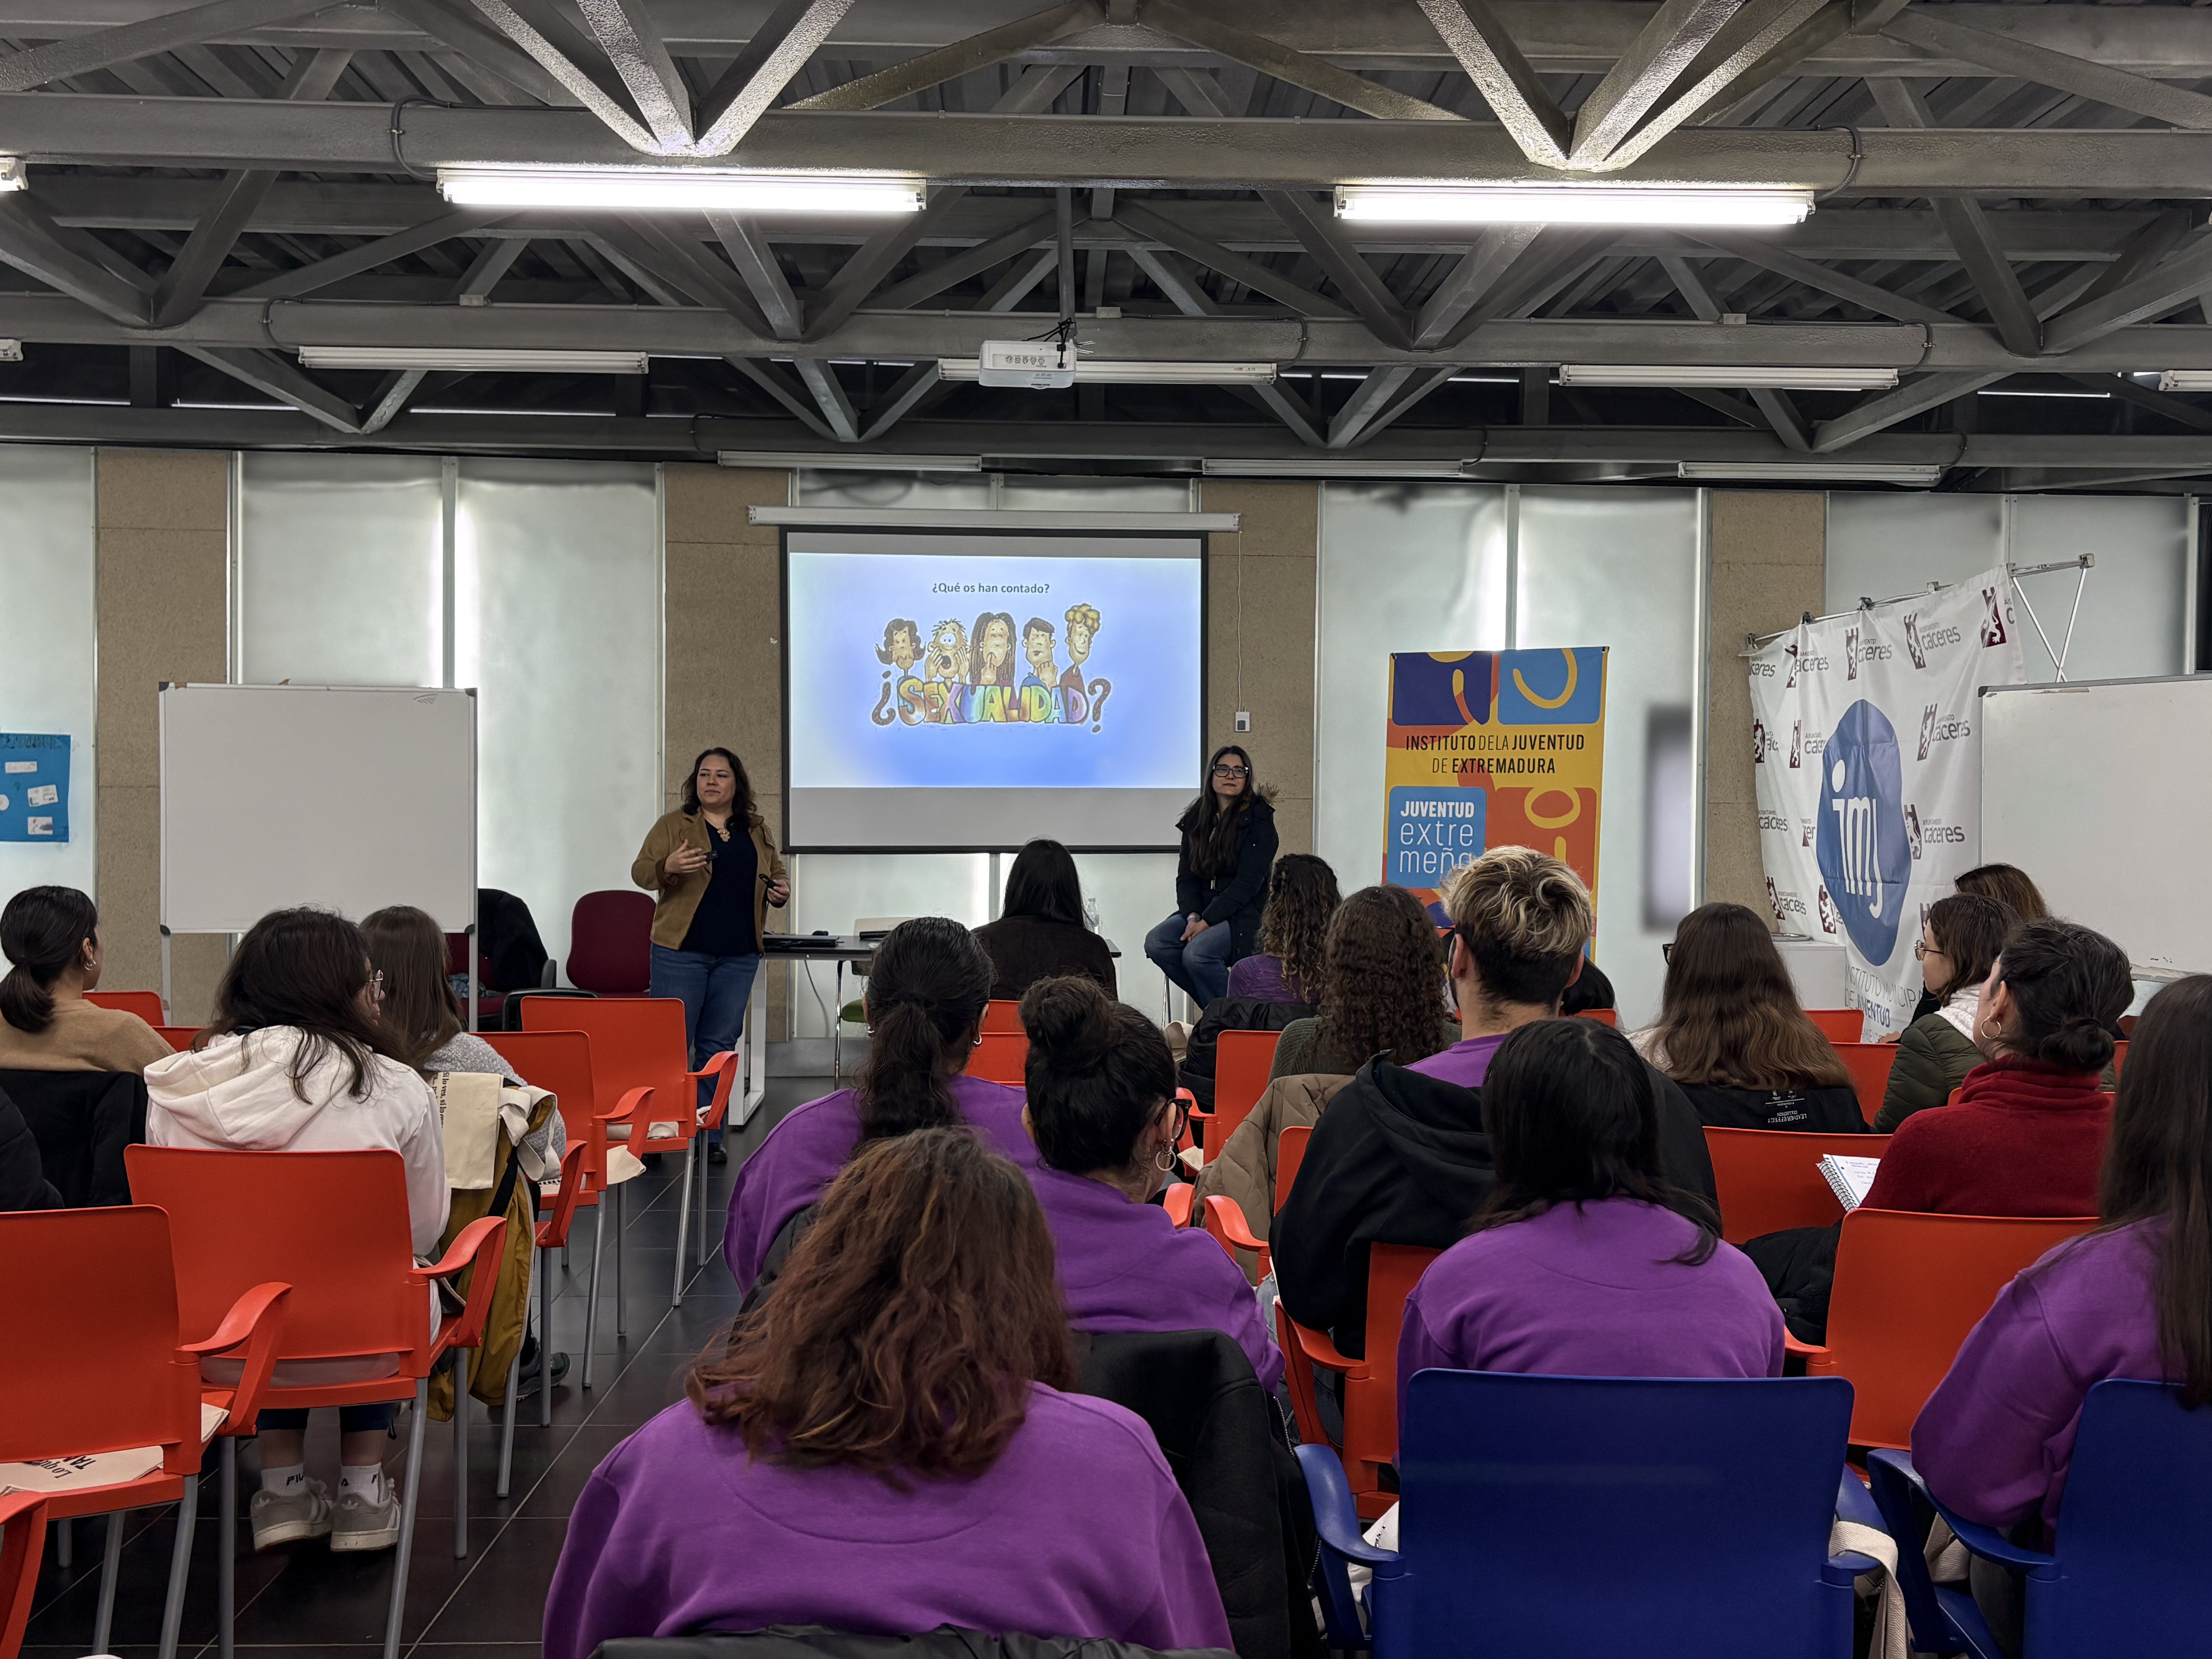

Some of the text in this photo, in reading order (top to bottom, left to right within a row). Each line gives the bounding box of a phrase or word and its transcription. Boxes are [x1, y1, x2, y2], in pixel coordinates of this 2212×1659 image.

[932, 582, 960, 593] ¿Qué
[979, 582, 998, 592] han
[1001, 583, 1050, 593] contado?
[871, 670, 1112, 733] ¿SEXUALIDAD?
[1406, 735, 1476, 750] INSTITUTO
[1512, 734, 1585, 750] JUVENTUD
[1432, 757, 1556, 774] DE EXTREMADURA
[1400, 800, 1475, 818] JUVENTUD
[1400, 820, 1474, 847] extre
[286, 1473, 304, 1486] FIL
